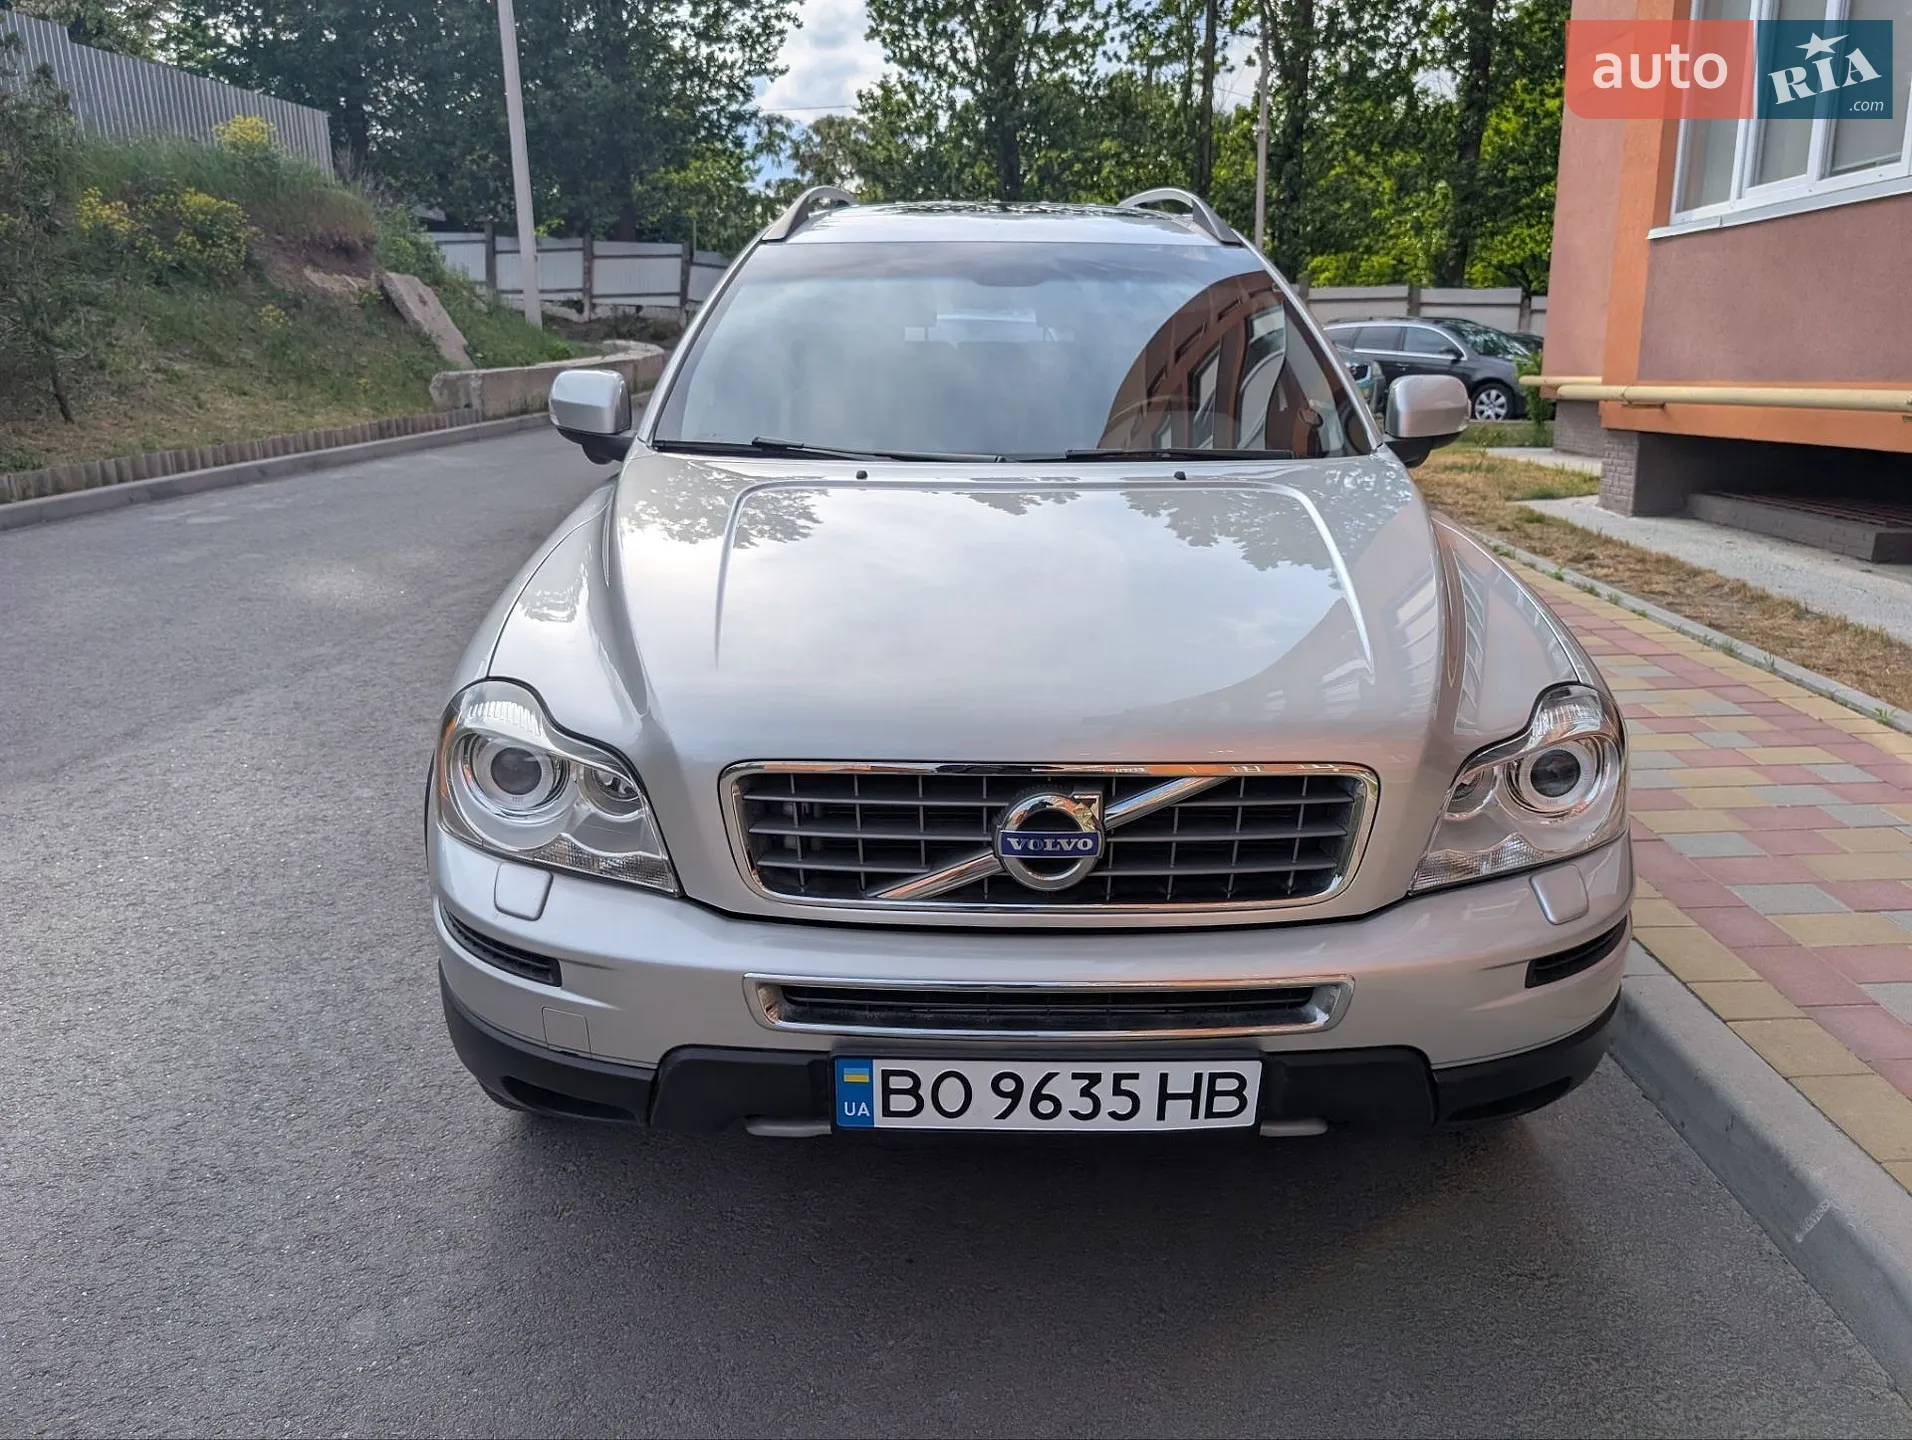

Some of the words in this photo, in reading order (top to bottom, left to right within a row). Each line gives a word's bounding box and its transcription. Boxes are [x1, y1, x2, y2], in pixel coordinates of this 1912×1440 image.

[1006, 838, 1094, 851] VOLVO
[880, 1069, 973, 1119] BO
[990, 1071, 1141, 1121] 9635
[1156, 1072, 1249, 1120] HB
[844, 1101, 871, 1116] UA
